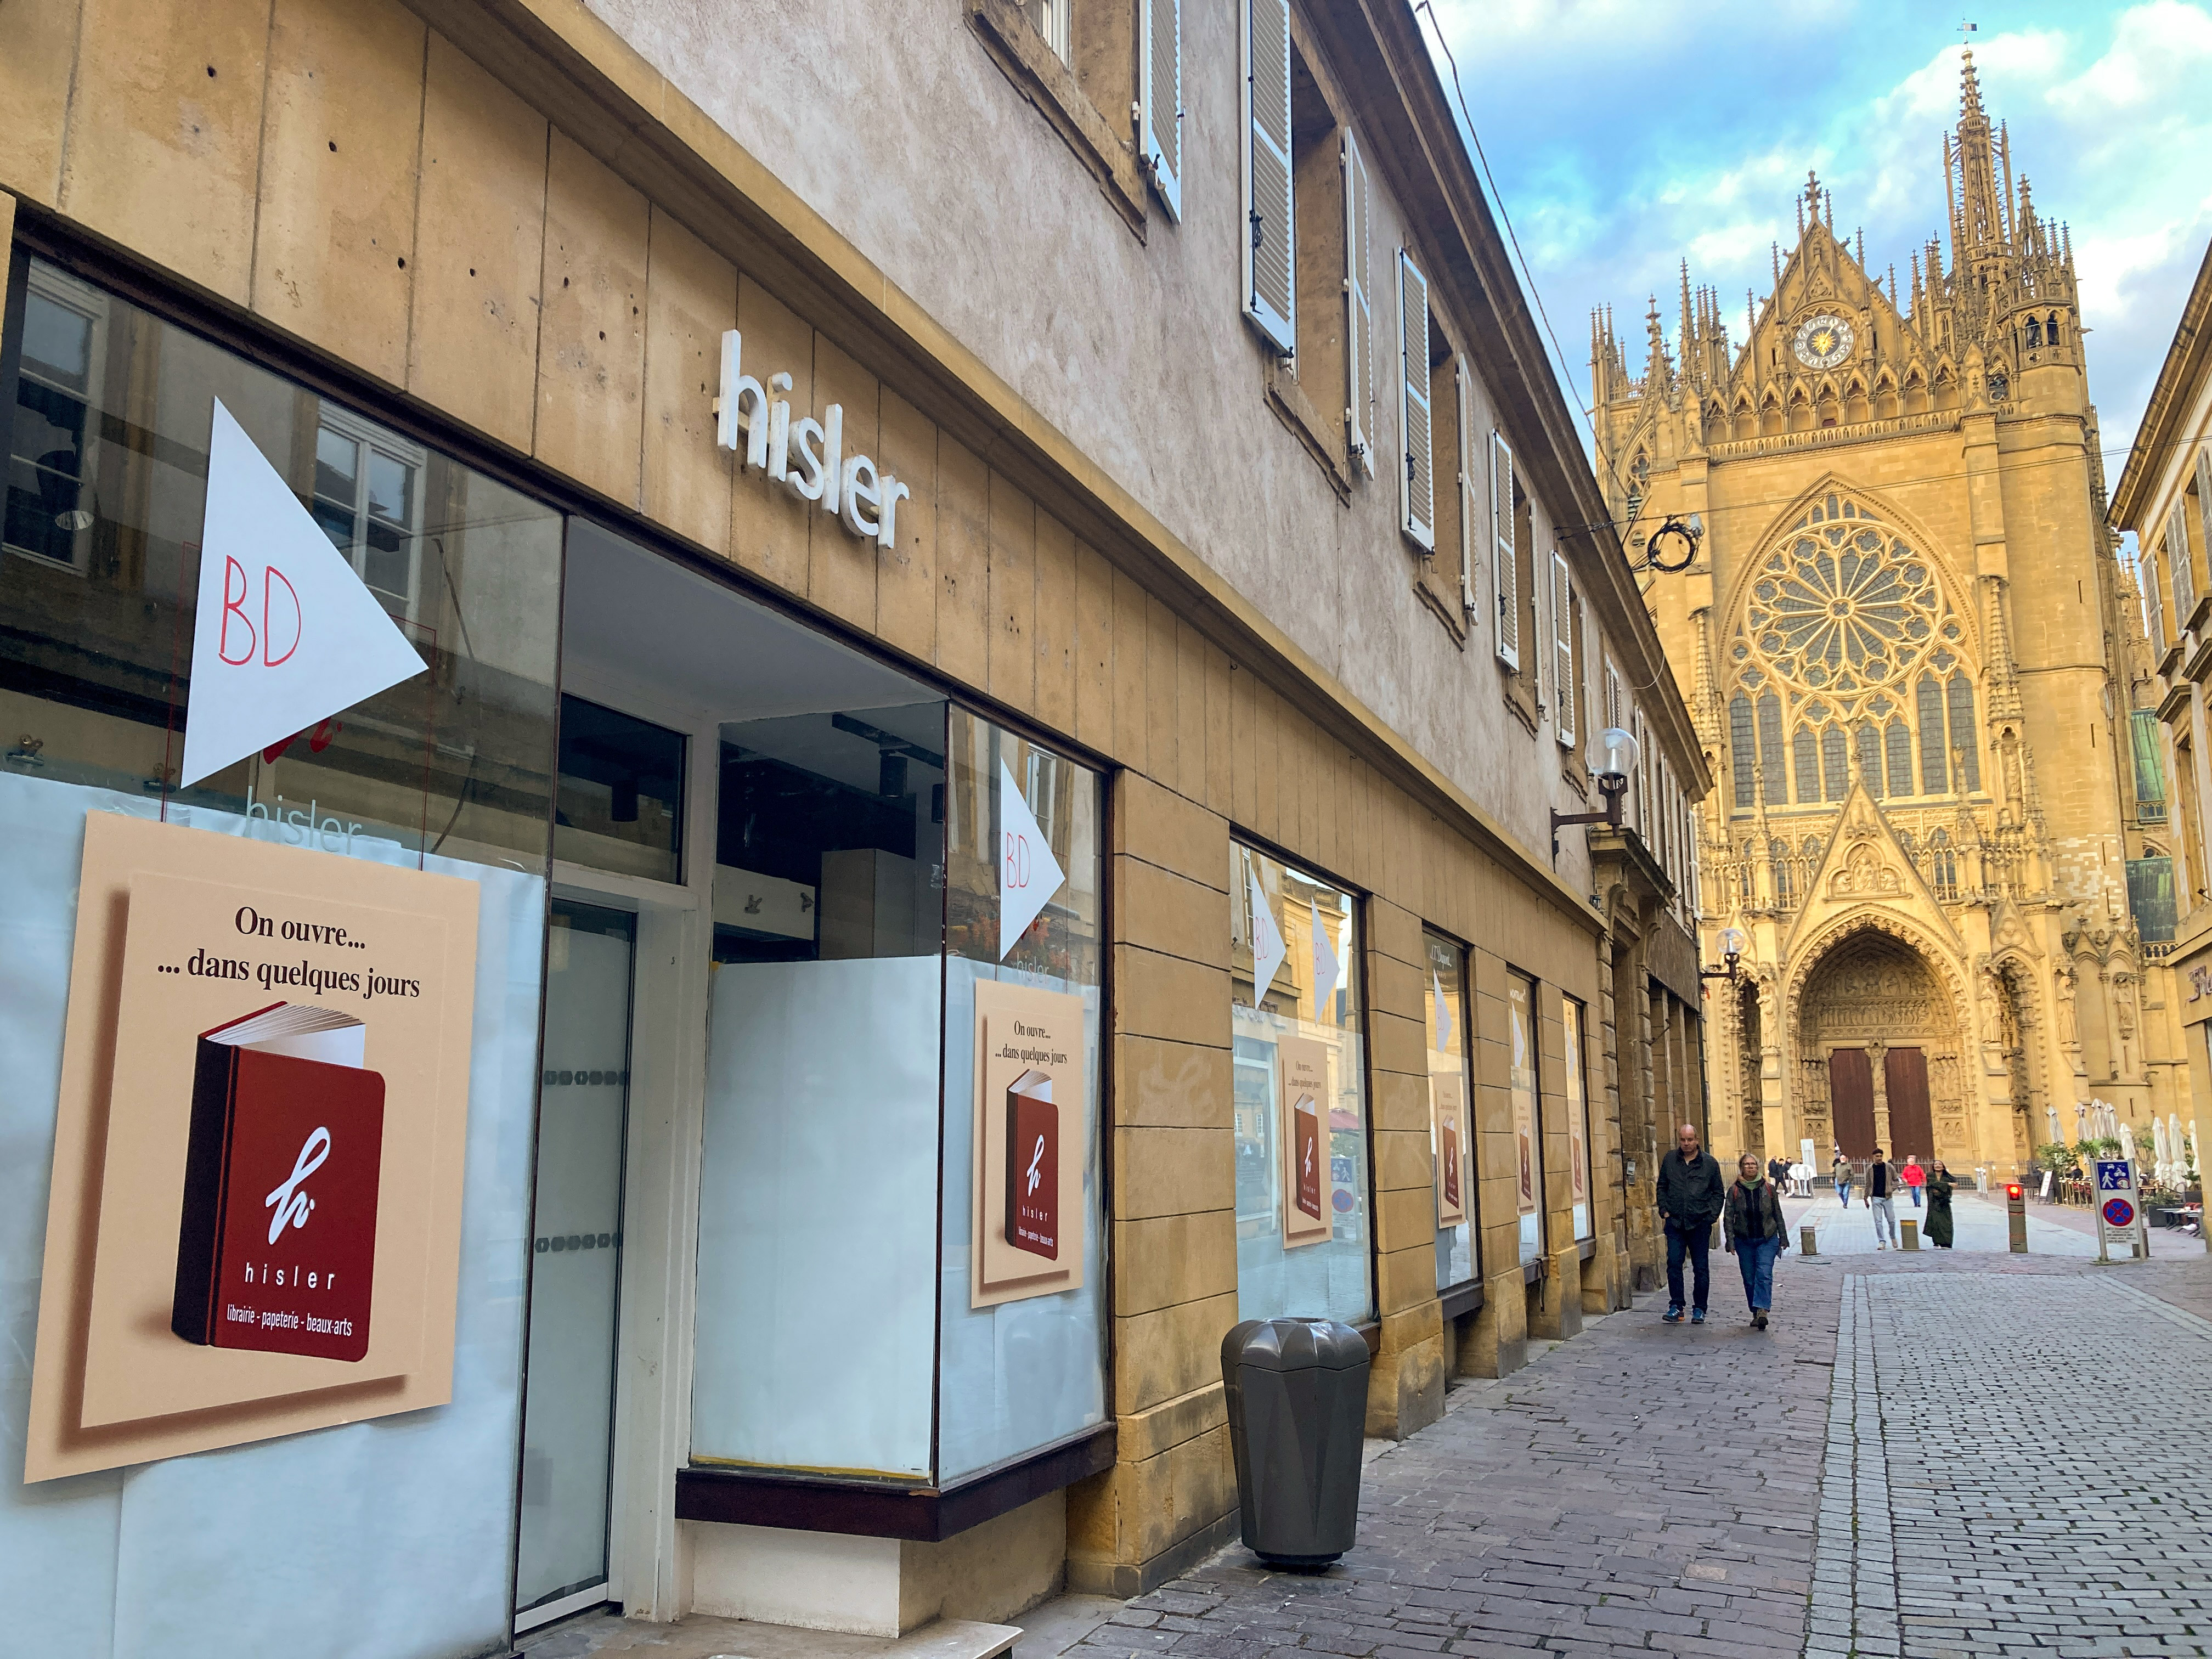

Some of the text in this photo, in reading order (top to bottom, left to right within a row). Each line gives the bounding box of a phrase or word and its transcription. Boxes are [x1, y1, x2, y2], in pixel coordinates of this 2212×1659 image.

[718, 329, 909, 549] hisler
[219, 555, 301, 667] BD
[244, 786, 362, 855] hisler
[1007, 832, 1030, 888] BD
[235, 906, 365, 949] On ouvre...
[1255, 916, 1269, 960] BD
[1016, 951, 1049, 984] hisler
[1316, 943, 1327, 975] BD
[256, 960, 360, 995] quelques
[363, 967, 420, 1000] jours
[1014, 1020, 1051, 1039] On ouvre...
[1020, 1046, 1050, 1065] quelques
[1050, 1048, 1067, 1066] jours
[1022, 1205, 1048, 1222] hisler
[245, 1262, 336, 1290] hisler
[227, 1304, 255, 1324] librairie
[262, 1310, 298, 1329] papeterie
[306, 1313, 353, 1336] beaux-arts
